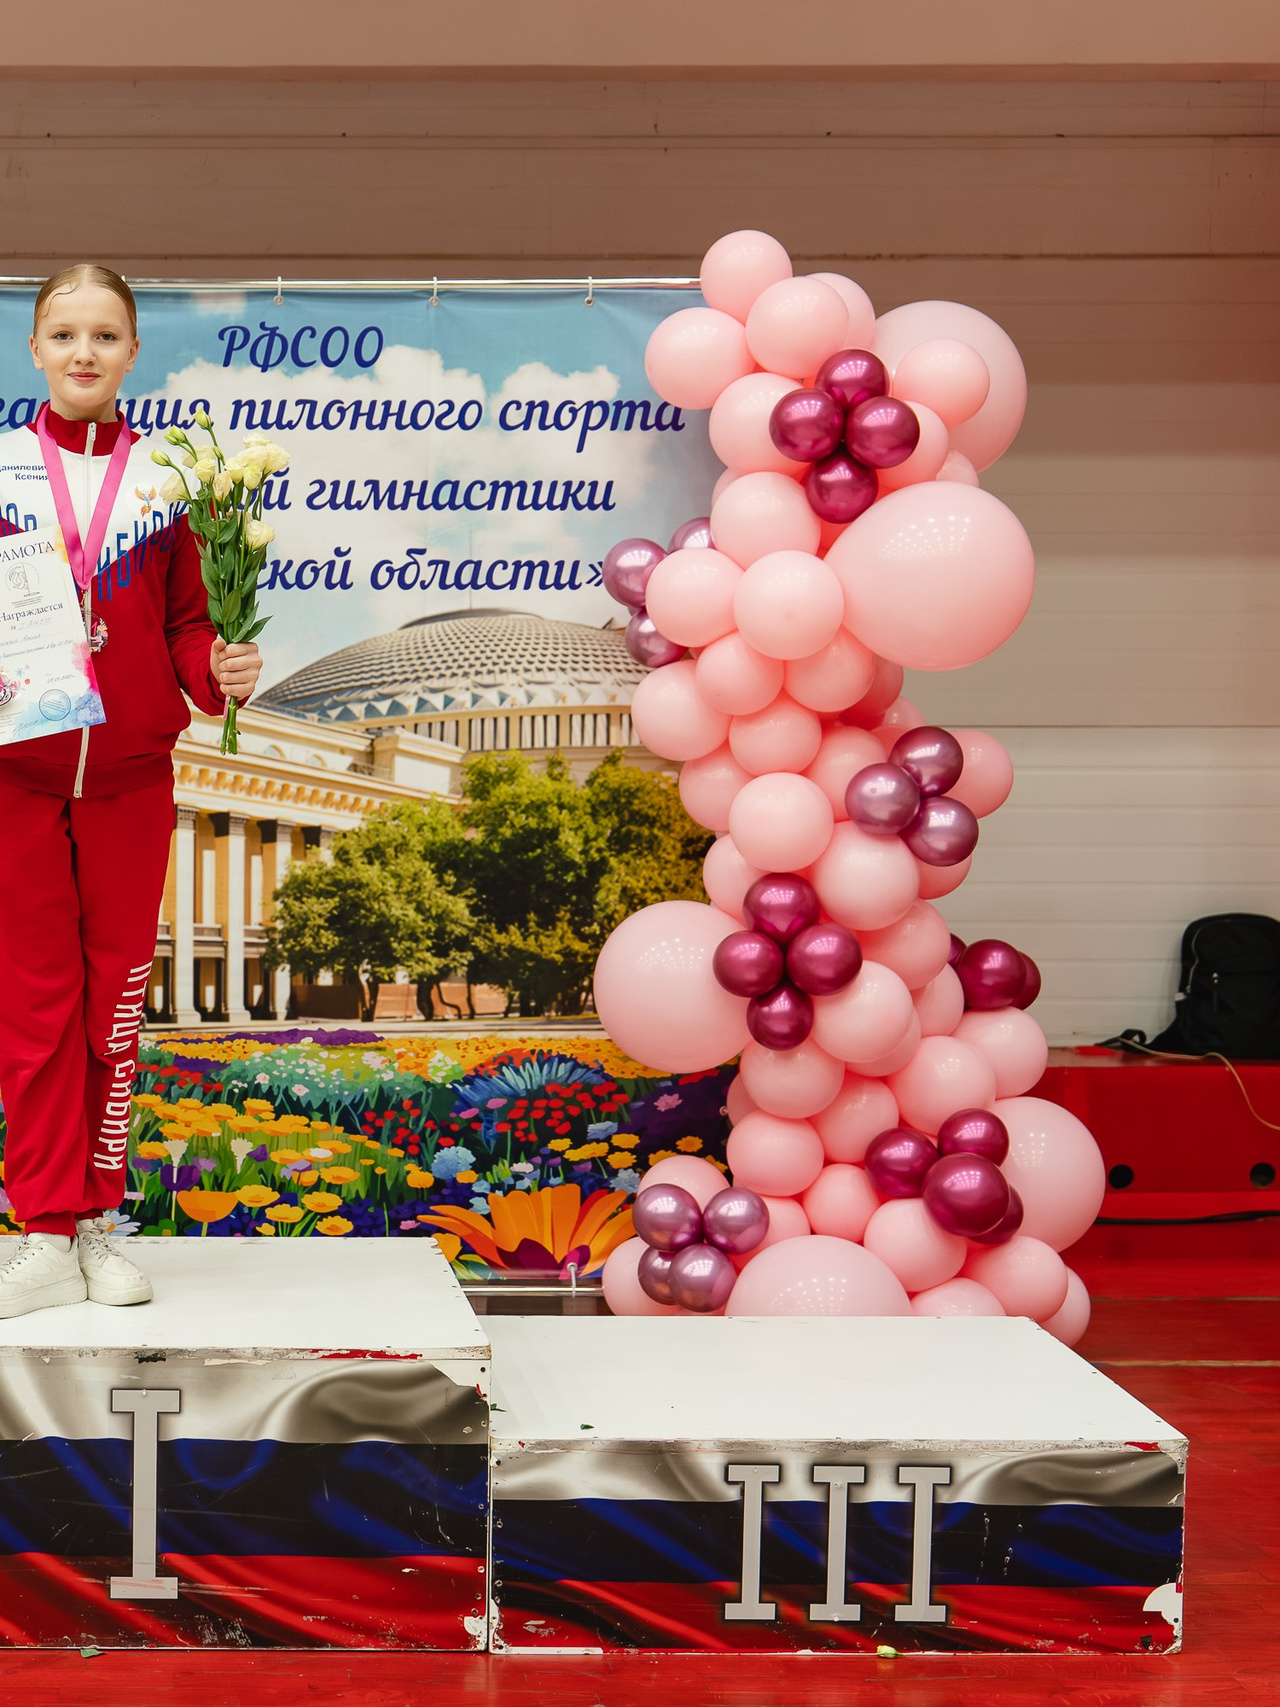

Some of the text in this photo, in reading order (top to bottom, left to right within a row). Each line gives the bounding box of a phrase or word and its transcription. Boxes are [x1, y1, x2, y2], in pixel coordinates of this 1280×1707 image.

[218, 321, 384, 373] РФСОО
[229, 398, 483, 431] пилонного
[498, 399, 686, 453] спорта
[306, 478, 616, 511] гимнастики
[370, 548, 604, 591] области»
[103, 960, 154, 1056] ПТИЦА
[109, 1388, 182, 1600] I
[724, 1464, 951, 1623] III
